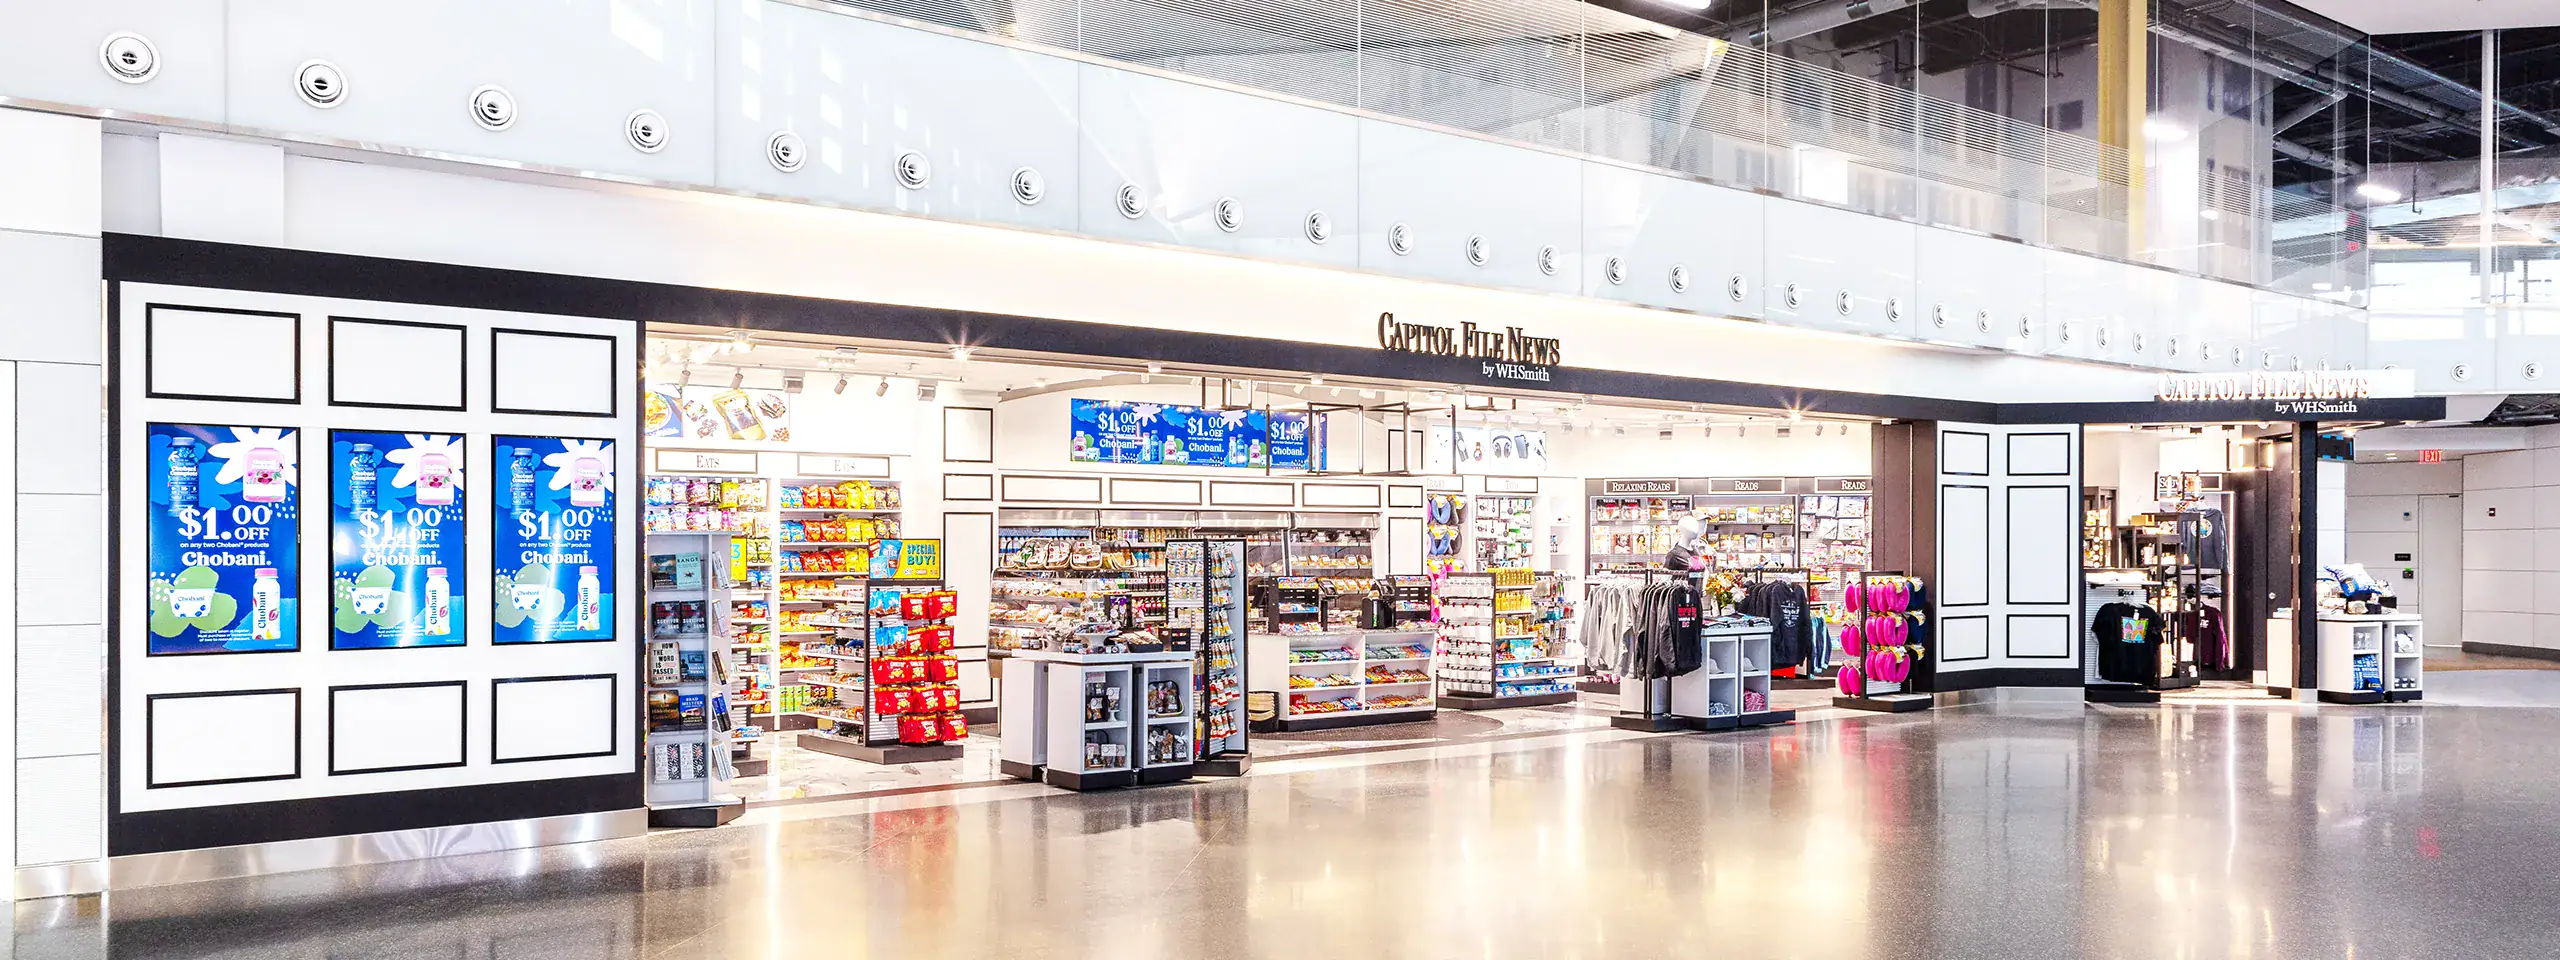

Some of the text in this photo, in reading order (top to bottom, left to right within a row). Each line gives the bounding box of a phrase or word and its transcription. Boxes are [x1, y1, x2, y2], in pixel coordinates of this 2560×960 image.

[1378, 312, 1560, 367] CAPITOL FILE NEWS
[1482, 362, 1550, 382] by WHSmith
[2158, 372, 2370, 401] CAPITOL FILE NEWS
[2275, 401, 2357, 414] by WHSmith
[1121, 425, 1137, 433] OFF
[696, 455, 719, 468] EATS
[2424, 451, 2442, 462] EXIT
[1612, 481, 1671, 491] RELAXING READS
[1735, 481, 1758, 491] READS
[1841, 480, 1865, 490] READS
[234, 527, 270, 540] OFF
[563, 529, 591, 541] OFF
[907, 544, 936, 554] SPECIAL
[907, 556, 935, 565] BUY!
[258, 592, 266, 628] Chobani
